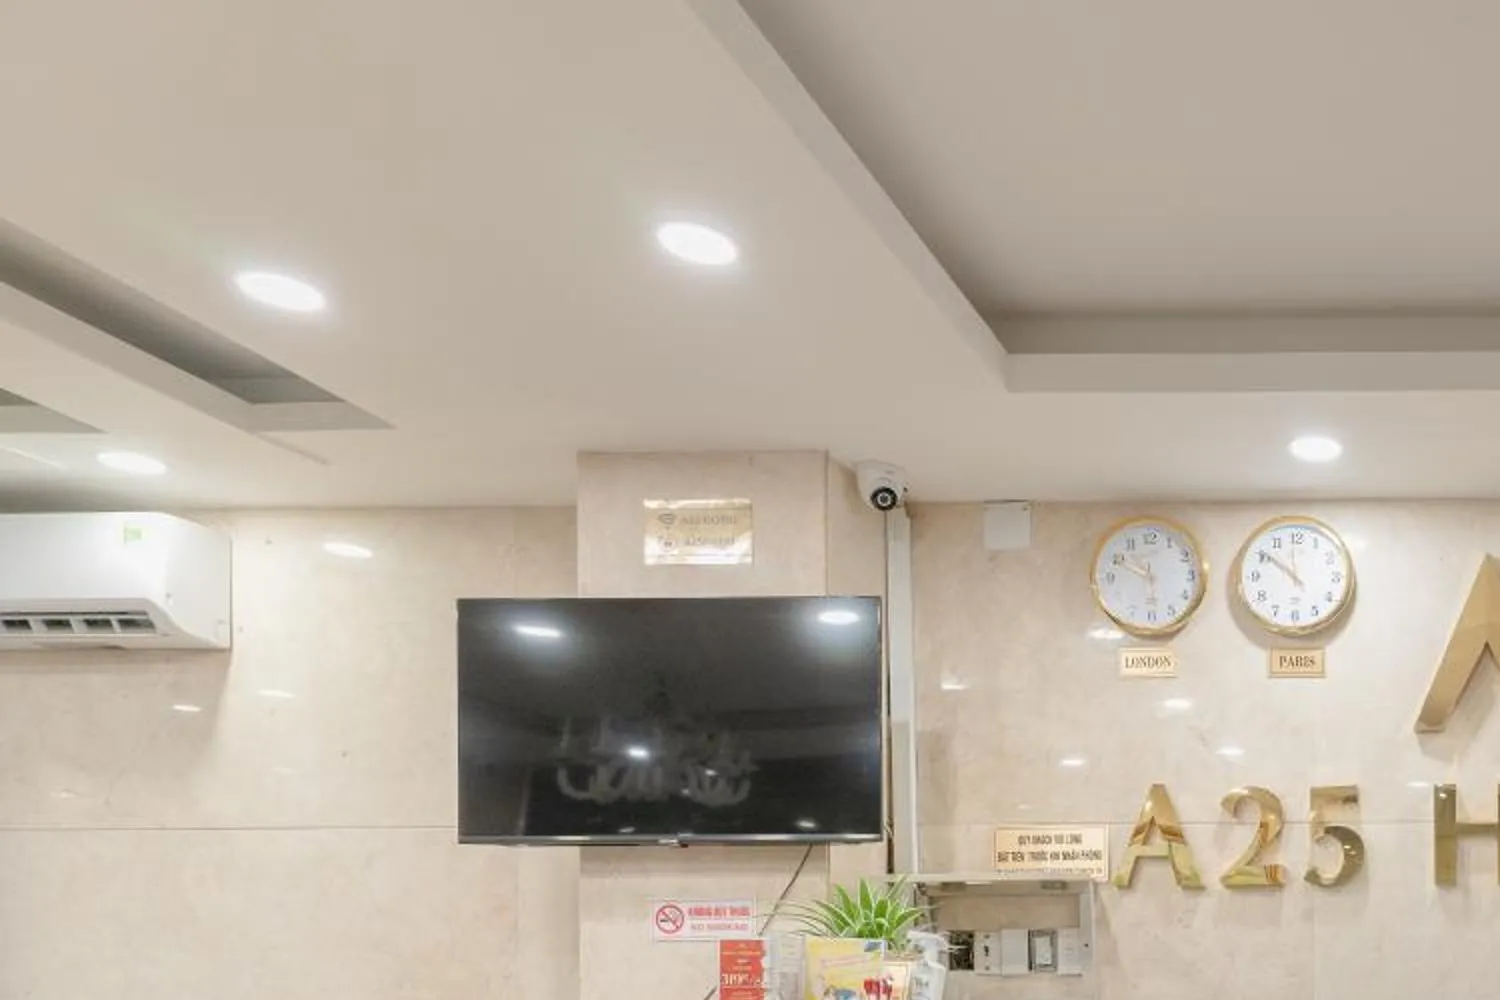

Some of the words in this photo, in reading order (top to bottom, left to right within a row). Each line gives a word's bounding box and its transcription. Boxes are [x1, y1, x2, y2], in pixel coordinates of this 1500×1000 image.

[1290, 532, 1304, 545] 12
[1125, 655, 1172, 669] LONDON
[1279, 655, 1316, 669] PARIS
[1114, 784, 1366, 891] A25
